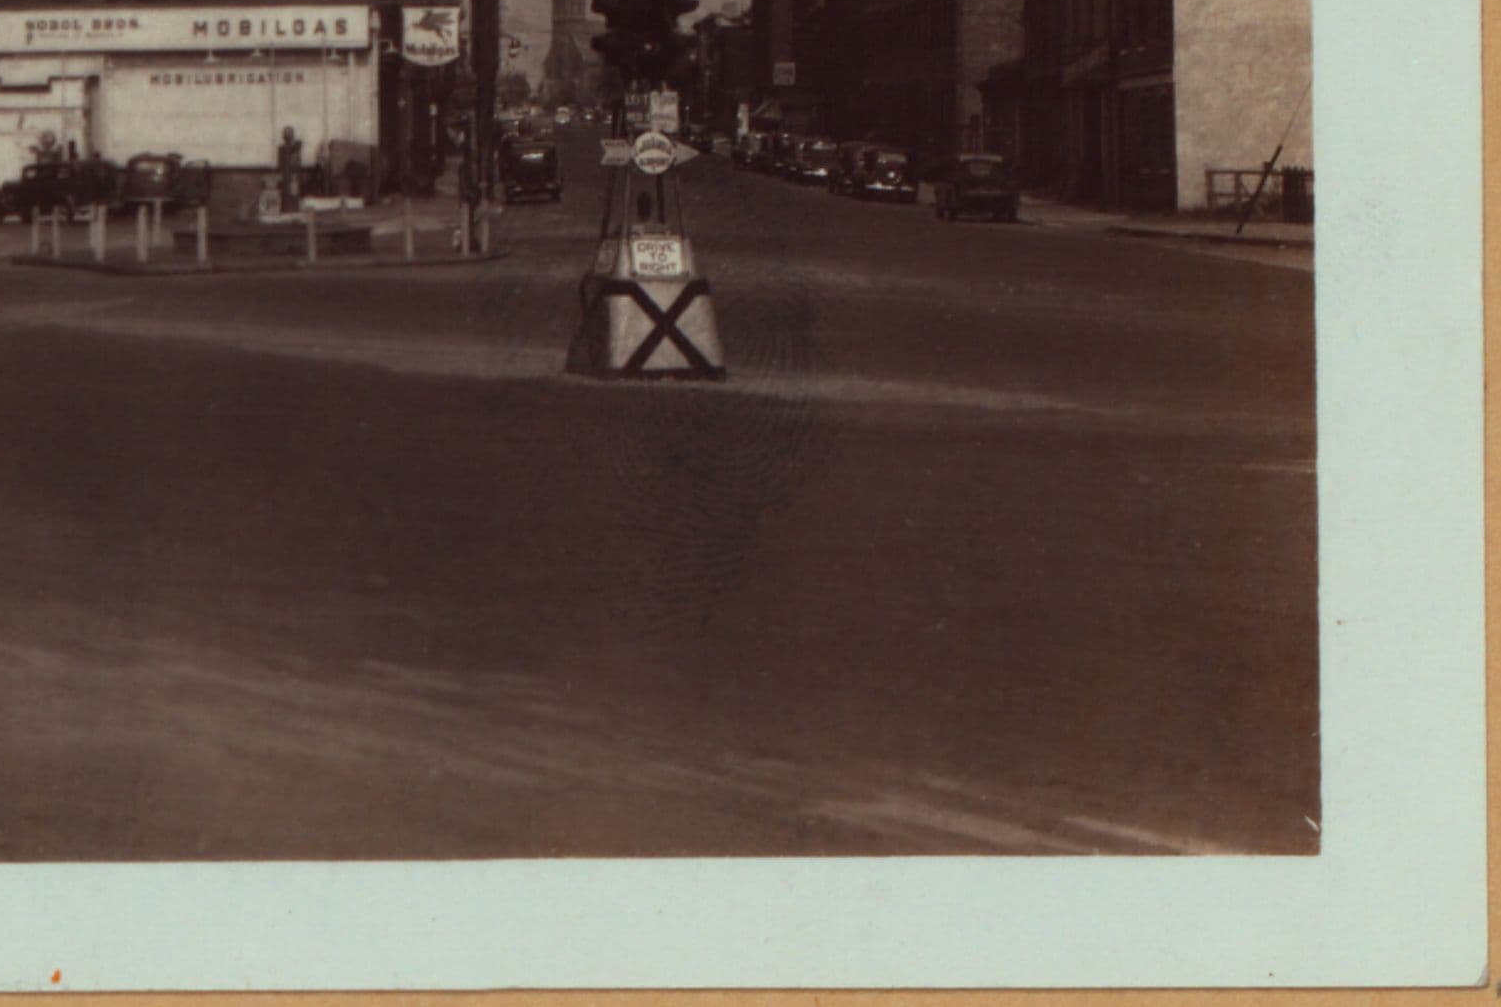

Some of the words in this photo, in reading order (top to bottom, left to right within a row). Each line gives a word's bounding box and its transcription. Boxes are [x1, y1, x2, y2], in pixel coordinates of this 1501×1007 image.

[193, 17, 349, 37] MOBILGAS
[636, 242, 677, 253] DRIVE
[650, 252, 668, 263] TO
